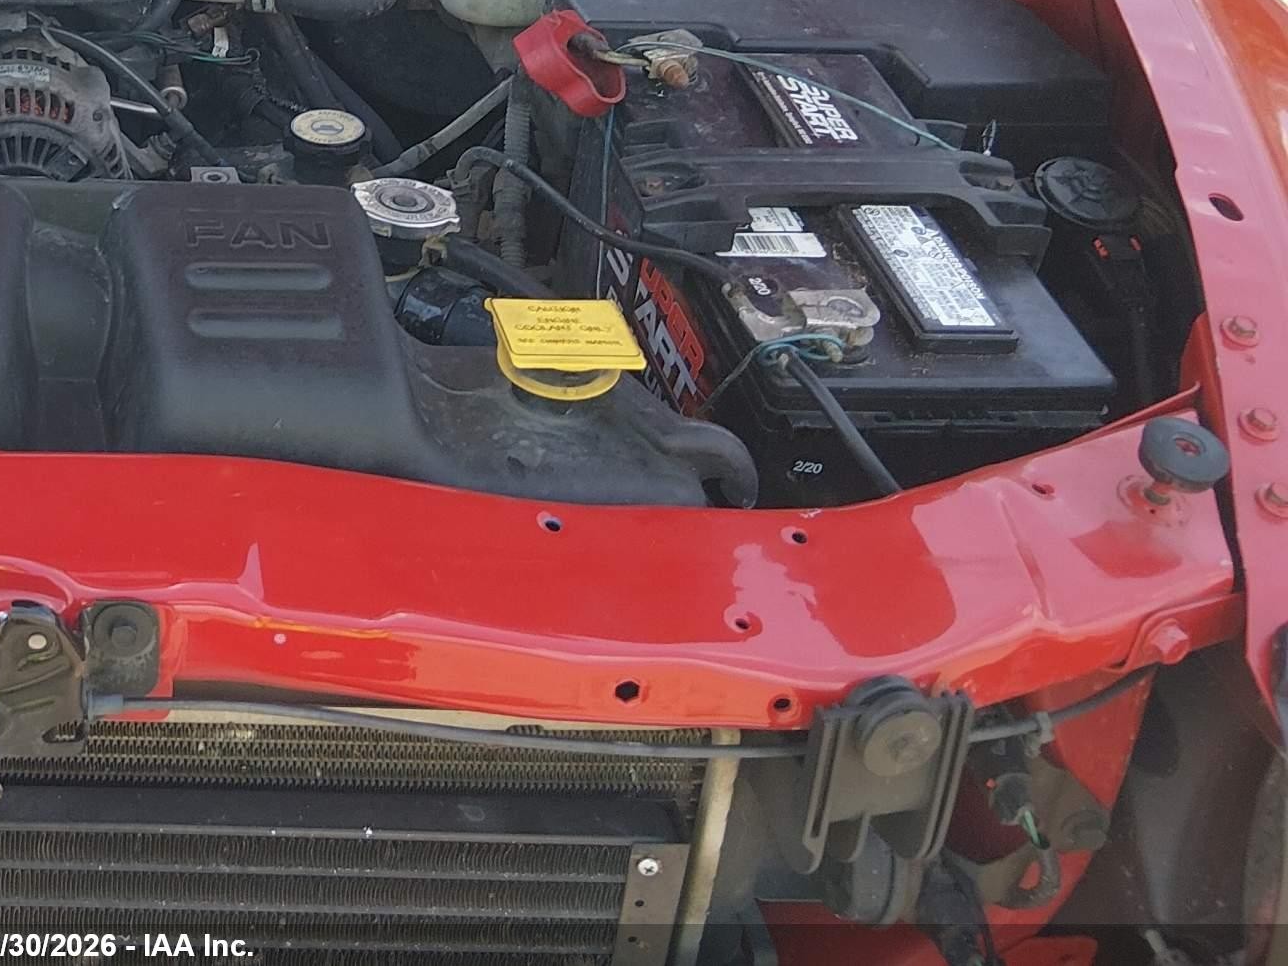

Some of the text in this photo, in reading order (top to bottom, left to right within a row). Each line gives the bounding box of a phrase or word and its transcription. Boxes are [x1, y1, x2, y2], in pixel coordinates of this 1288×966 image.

[776, 74, 842, 141] START
[800, 81, 859, 141] SUPER
[185, 220, 332, 249] FAN
[792, 459, 824, 475] 2/20
